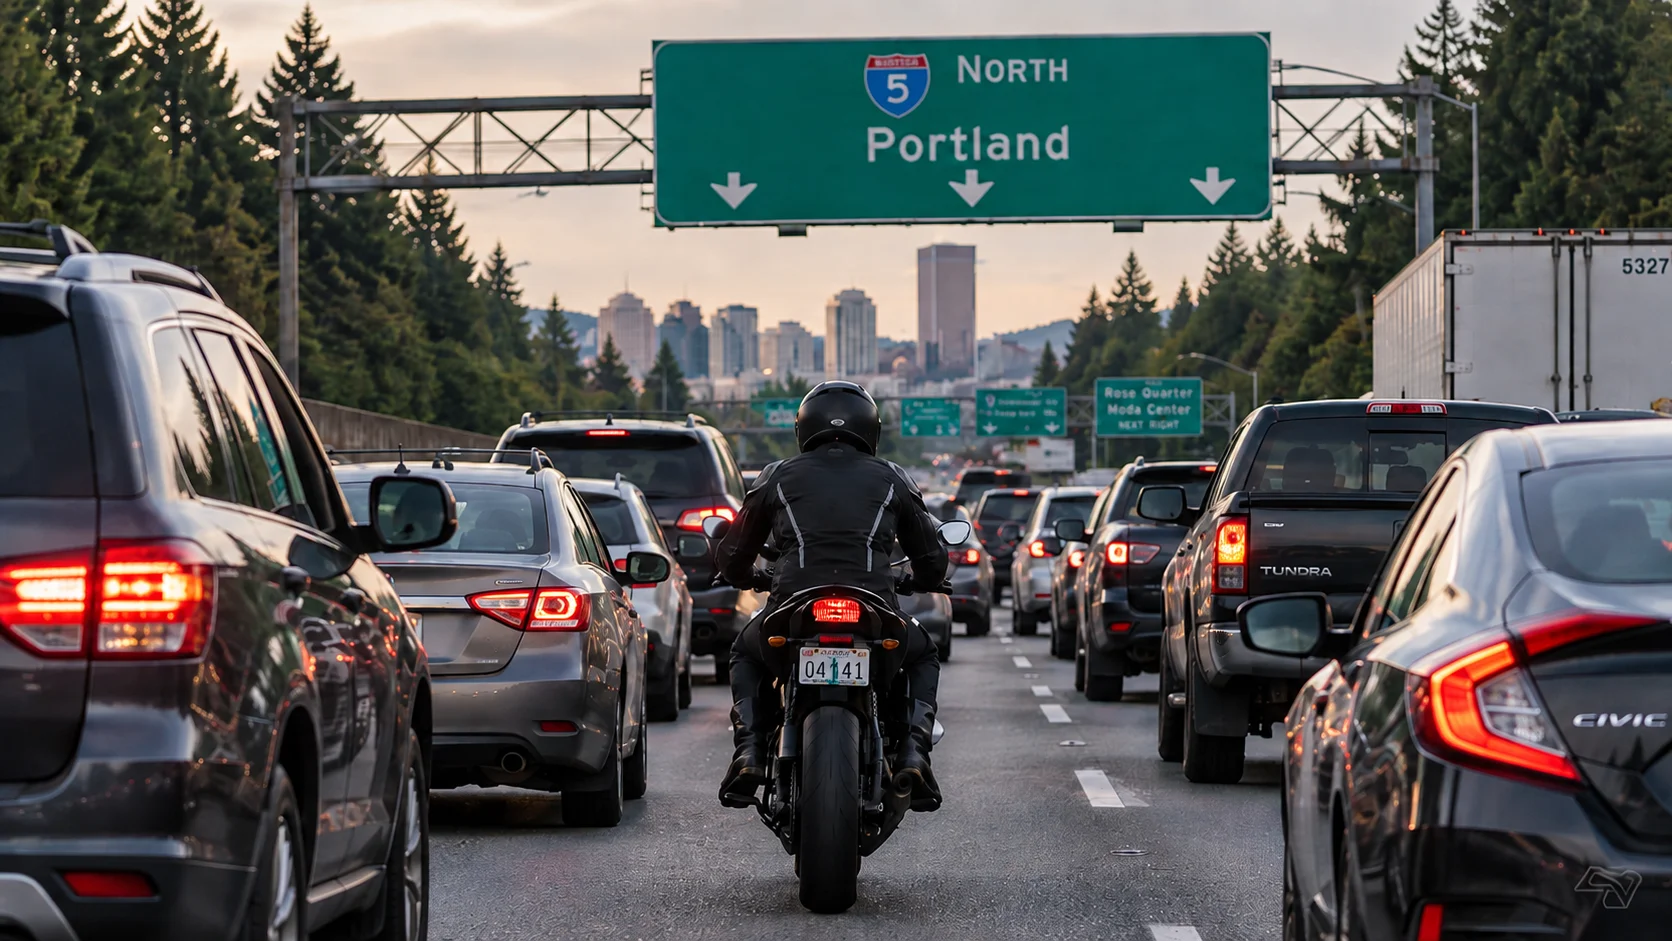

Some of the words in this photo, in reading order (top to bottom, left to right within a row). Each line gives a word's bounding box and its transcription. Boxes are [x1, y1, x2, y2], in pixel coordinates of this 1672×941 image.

[957, 54, 1068, 83] NORTH
[887, 73, 909, 104] 5
[867, 125, 1070, 163] Portland
[1622, 257, 1669, 275] 5327
[1104, 387, 1136, 398] Rose
[1142, 387, 1193, 399] Quarter
[1107, 404, 1142, 415] Moda
[1147, 403, 1191, 415] Center
[1118, 420, 1144, 430] NEXT
[1149, 420, 1179, 430] RIGHT
[1260, 566, 1332, 576] TUNDRA
[1572, 712, 1669, 728] CIVIC
